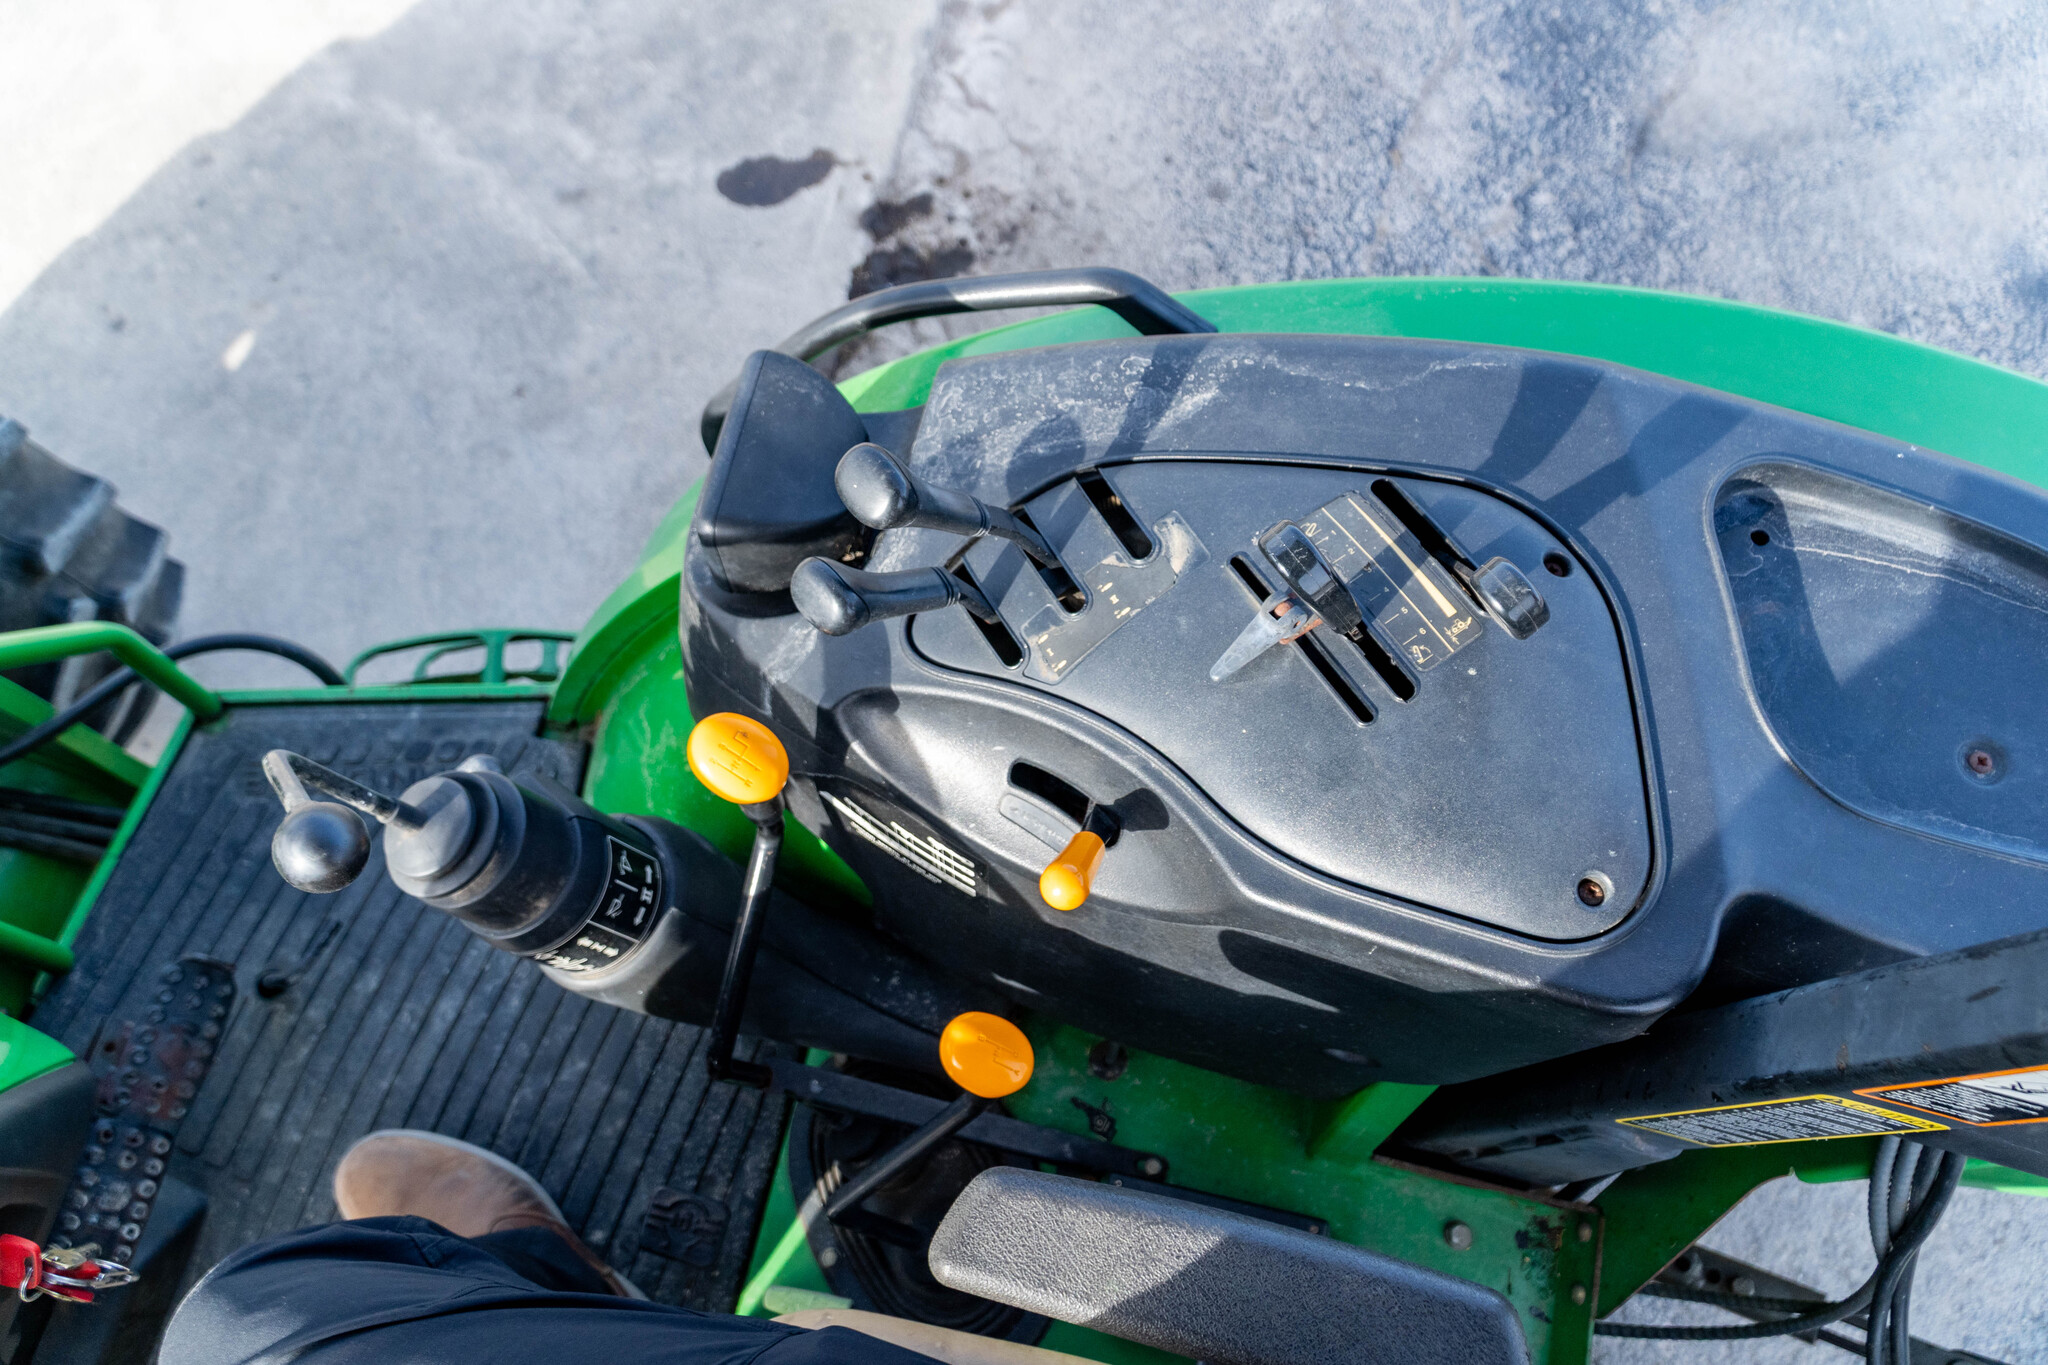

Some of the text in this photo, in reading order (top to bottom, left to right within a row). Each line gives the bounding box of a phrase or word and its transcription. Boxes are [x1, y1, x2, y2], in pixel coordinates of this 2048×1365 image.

[1347, 547, 1356, 555] 2
[1401, 606, 1409, 614] 5
[1419, 627, 1427, 635] 6
